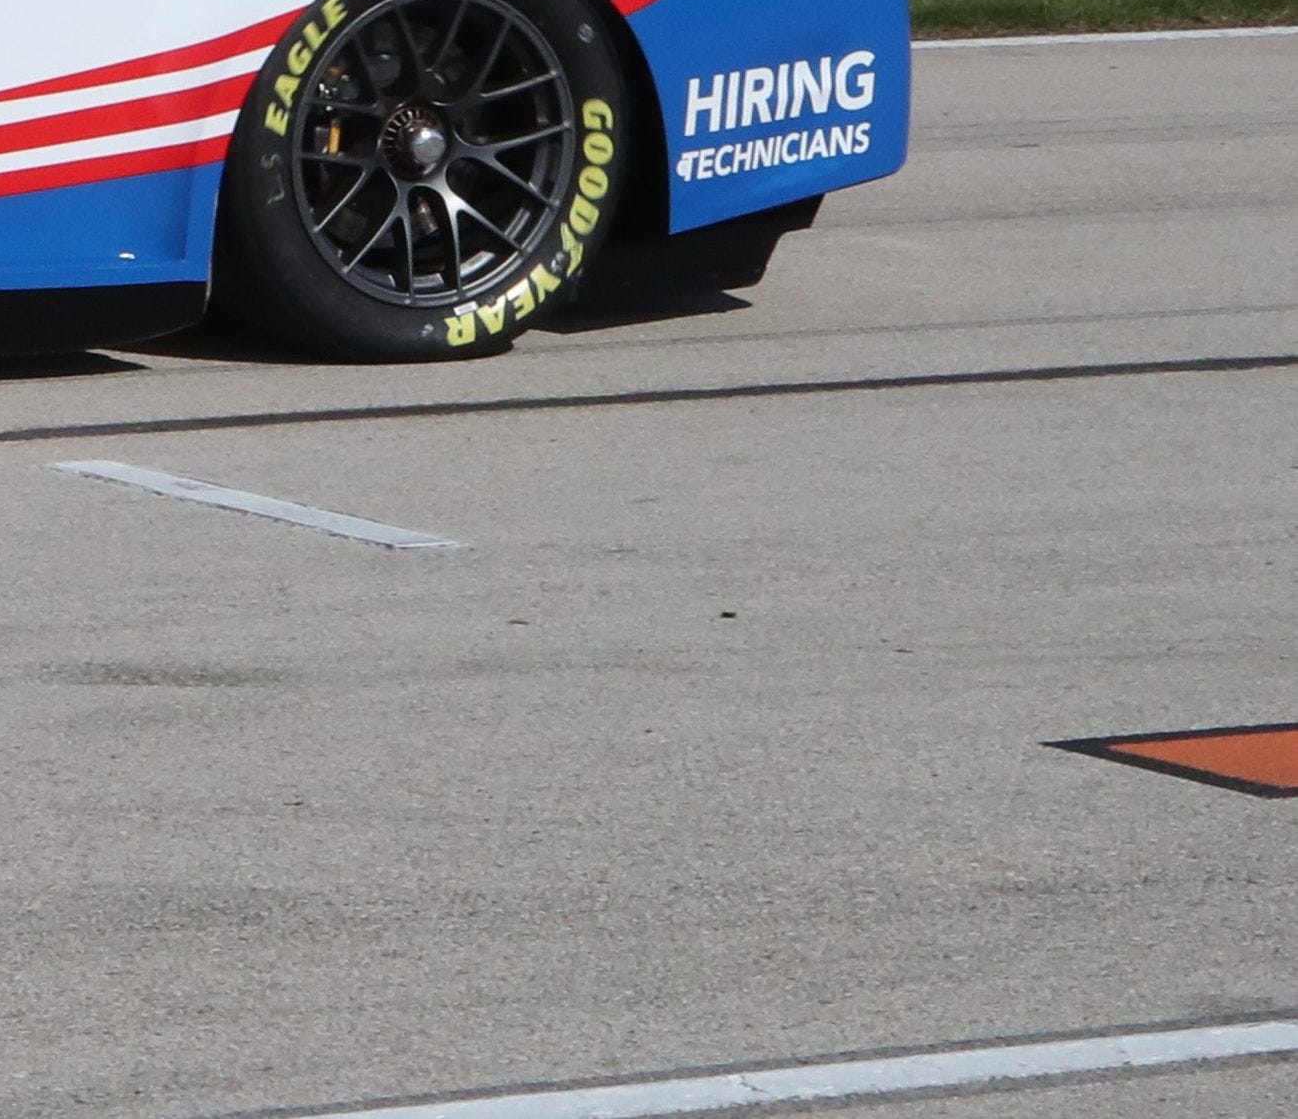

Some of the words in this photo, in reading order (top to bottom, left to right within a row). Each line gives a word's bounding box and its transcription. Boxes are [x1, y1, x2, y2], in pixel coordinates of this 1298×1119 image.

[684, 50, 877, 137] HIRING
[679, 122, 872, 182] TECHNICIANS
[443, 97, 614, 347] GOODYEAR
